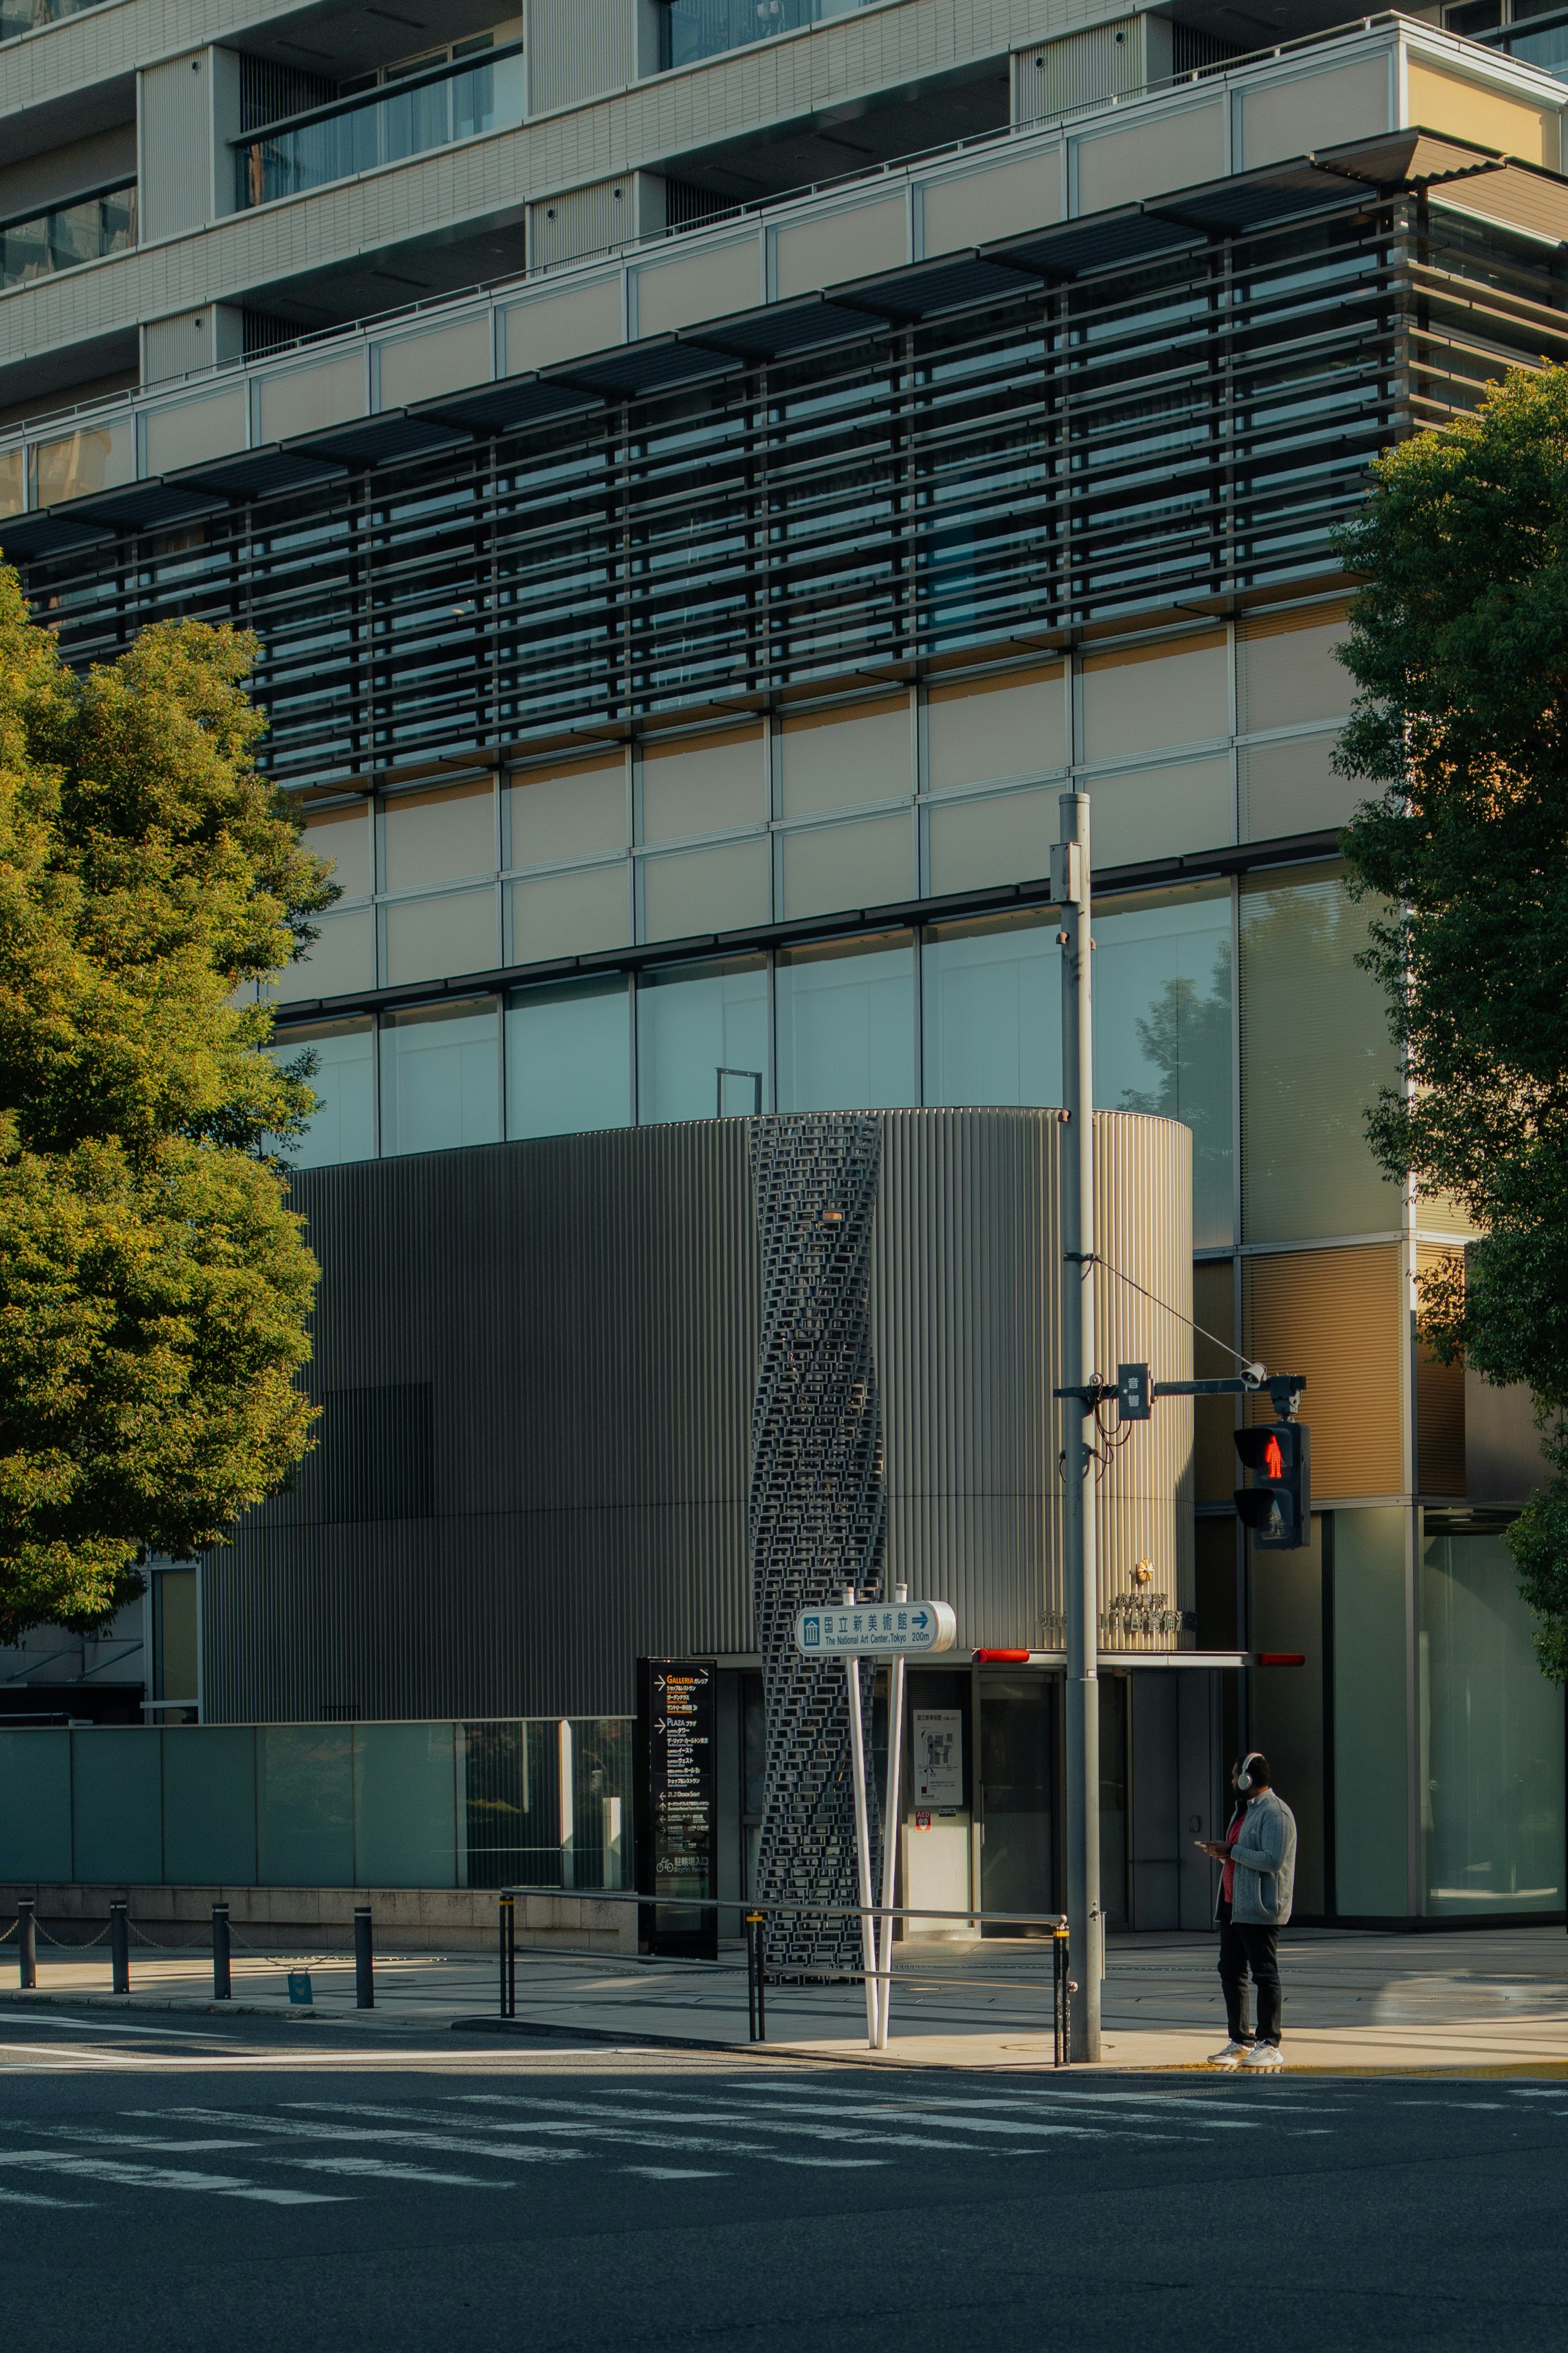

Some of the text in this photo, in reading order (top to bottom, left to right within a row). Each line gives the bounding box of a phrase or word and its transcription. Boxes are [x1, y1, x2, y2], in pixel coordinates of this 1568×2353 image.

[1128, 1377, 1139, 1406] 音響
[825, 1613, 907, 1633] 国立新美術館
[826, 1636, 836, 1645] The
[837, 1635, 859, 1645] National
[860, 1634, 869, 1644] Art
[912, 1632, 929, 1641] 200m
[667, 1675, 694, 1684] GALLERIA
[667, 1717, 685, 1726] PLAZA
[674, 1856, 709, 1866] 駐輪場入口
